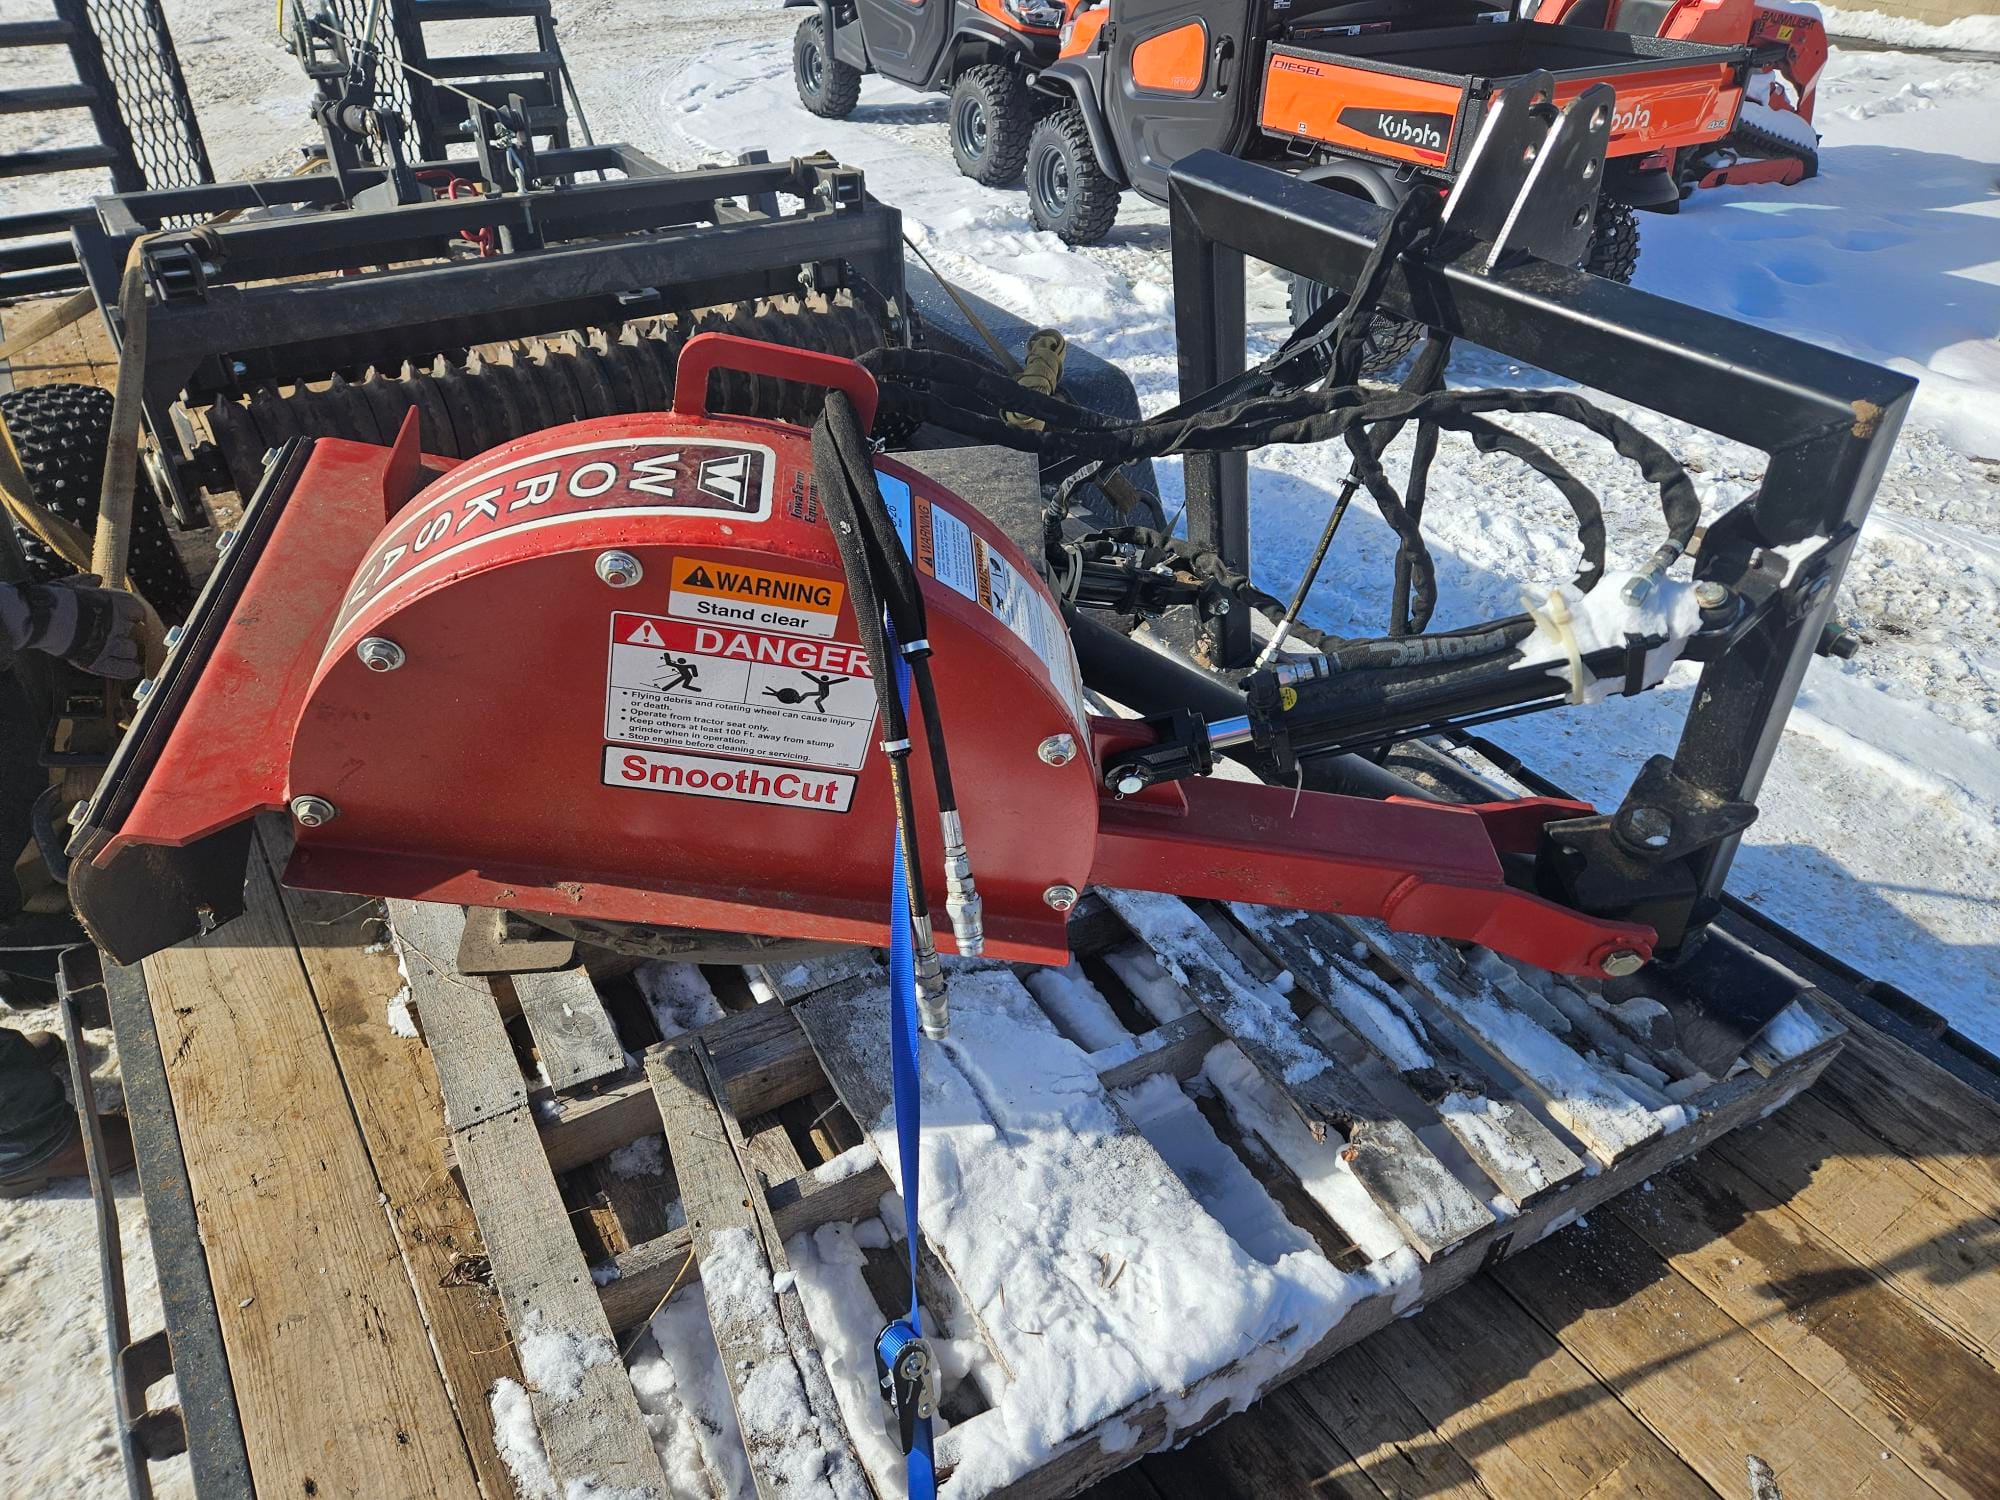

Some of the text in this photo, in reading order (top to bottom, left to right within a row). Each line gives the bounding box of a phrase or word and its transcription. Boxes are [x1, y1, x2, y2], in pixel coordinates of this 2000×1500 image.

[1273, 60, 1325, 77] DIESEL
[1378, 113, 1441, 148] Kubota
[1610, 103, 1651, 132] bota
[919, 504, 933, 554] WARNING
[716, 571, 831, 607] WARNING
[697, 601, 809, 629] Stand clear
[695, 628, 873, 676] DANGER
[630, 709, 667, 718] Operate
[670, 713, 691, 721] from
[694, 716, 724, 725] tractor
[748, 723, 769, 732] only.
[631, 691, 661, 701] Flying
[663, 695, 692, 705] debris
[695, 700, 713, 708] and
[715, 702, 751, 713] rotating
[754, 707, 780, 716] wheel
[801, 714, 828, 722] cause
[830, 718, 855, 727] injury
[643, 702, 672, 711] death.
[628, 725, 662, 734] grinder
[665, 729, 689, 737] when
[703, 734, 748, 745] operation.
[628, 732, 649, 741] Stop
[652, 737, 683, 746] engine
[686, 740, 714, 749] before
[717, 744, 754, 755] cleaning
[768, 751, 811, 761] servicing.
[630, 716, 654, 726] Keep
[656, 720, 686, 729] others
[700, 726, 722, 734] least
[726, 728, 741, 736] 100
[744, 730, 755, 738] Ft.
[758, 734, 781, 742] away
[783, 736, 804, 744] from
[806, 740, 834, 748] stump
[621, 754, 839, 804] SmoothCut
